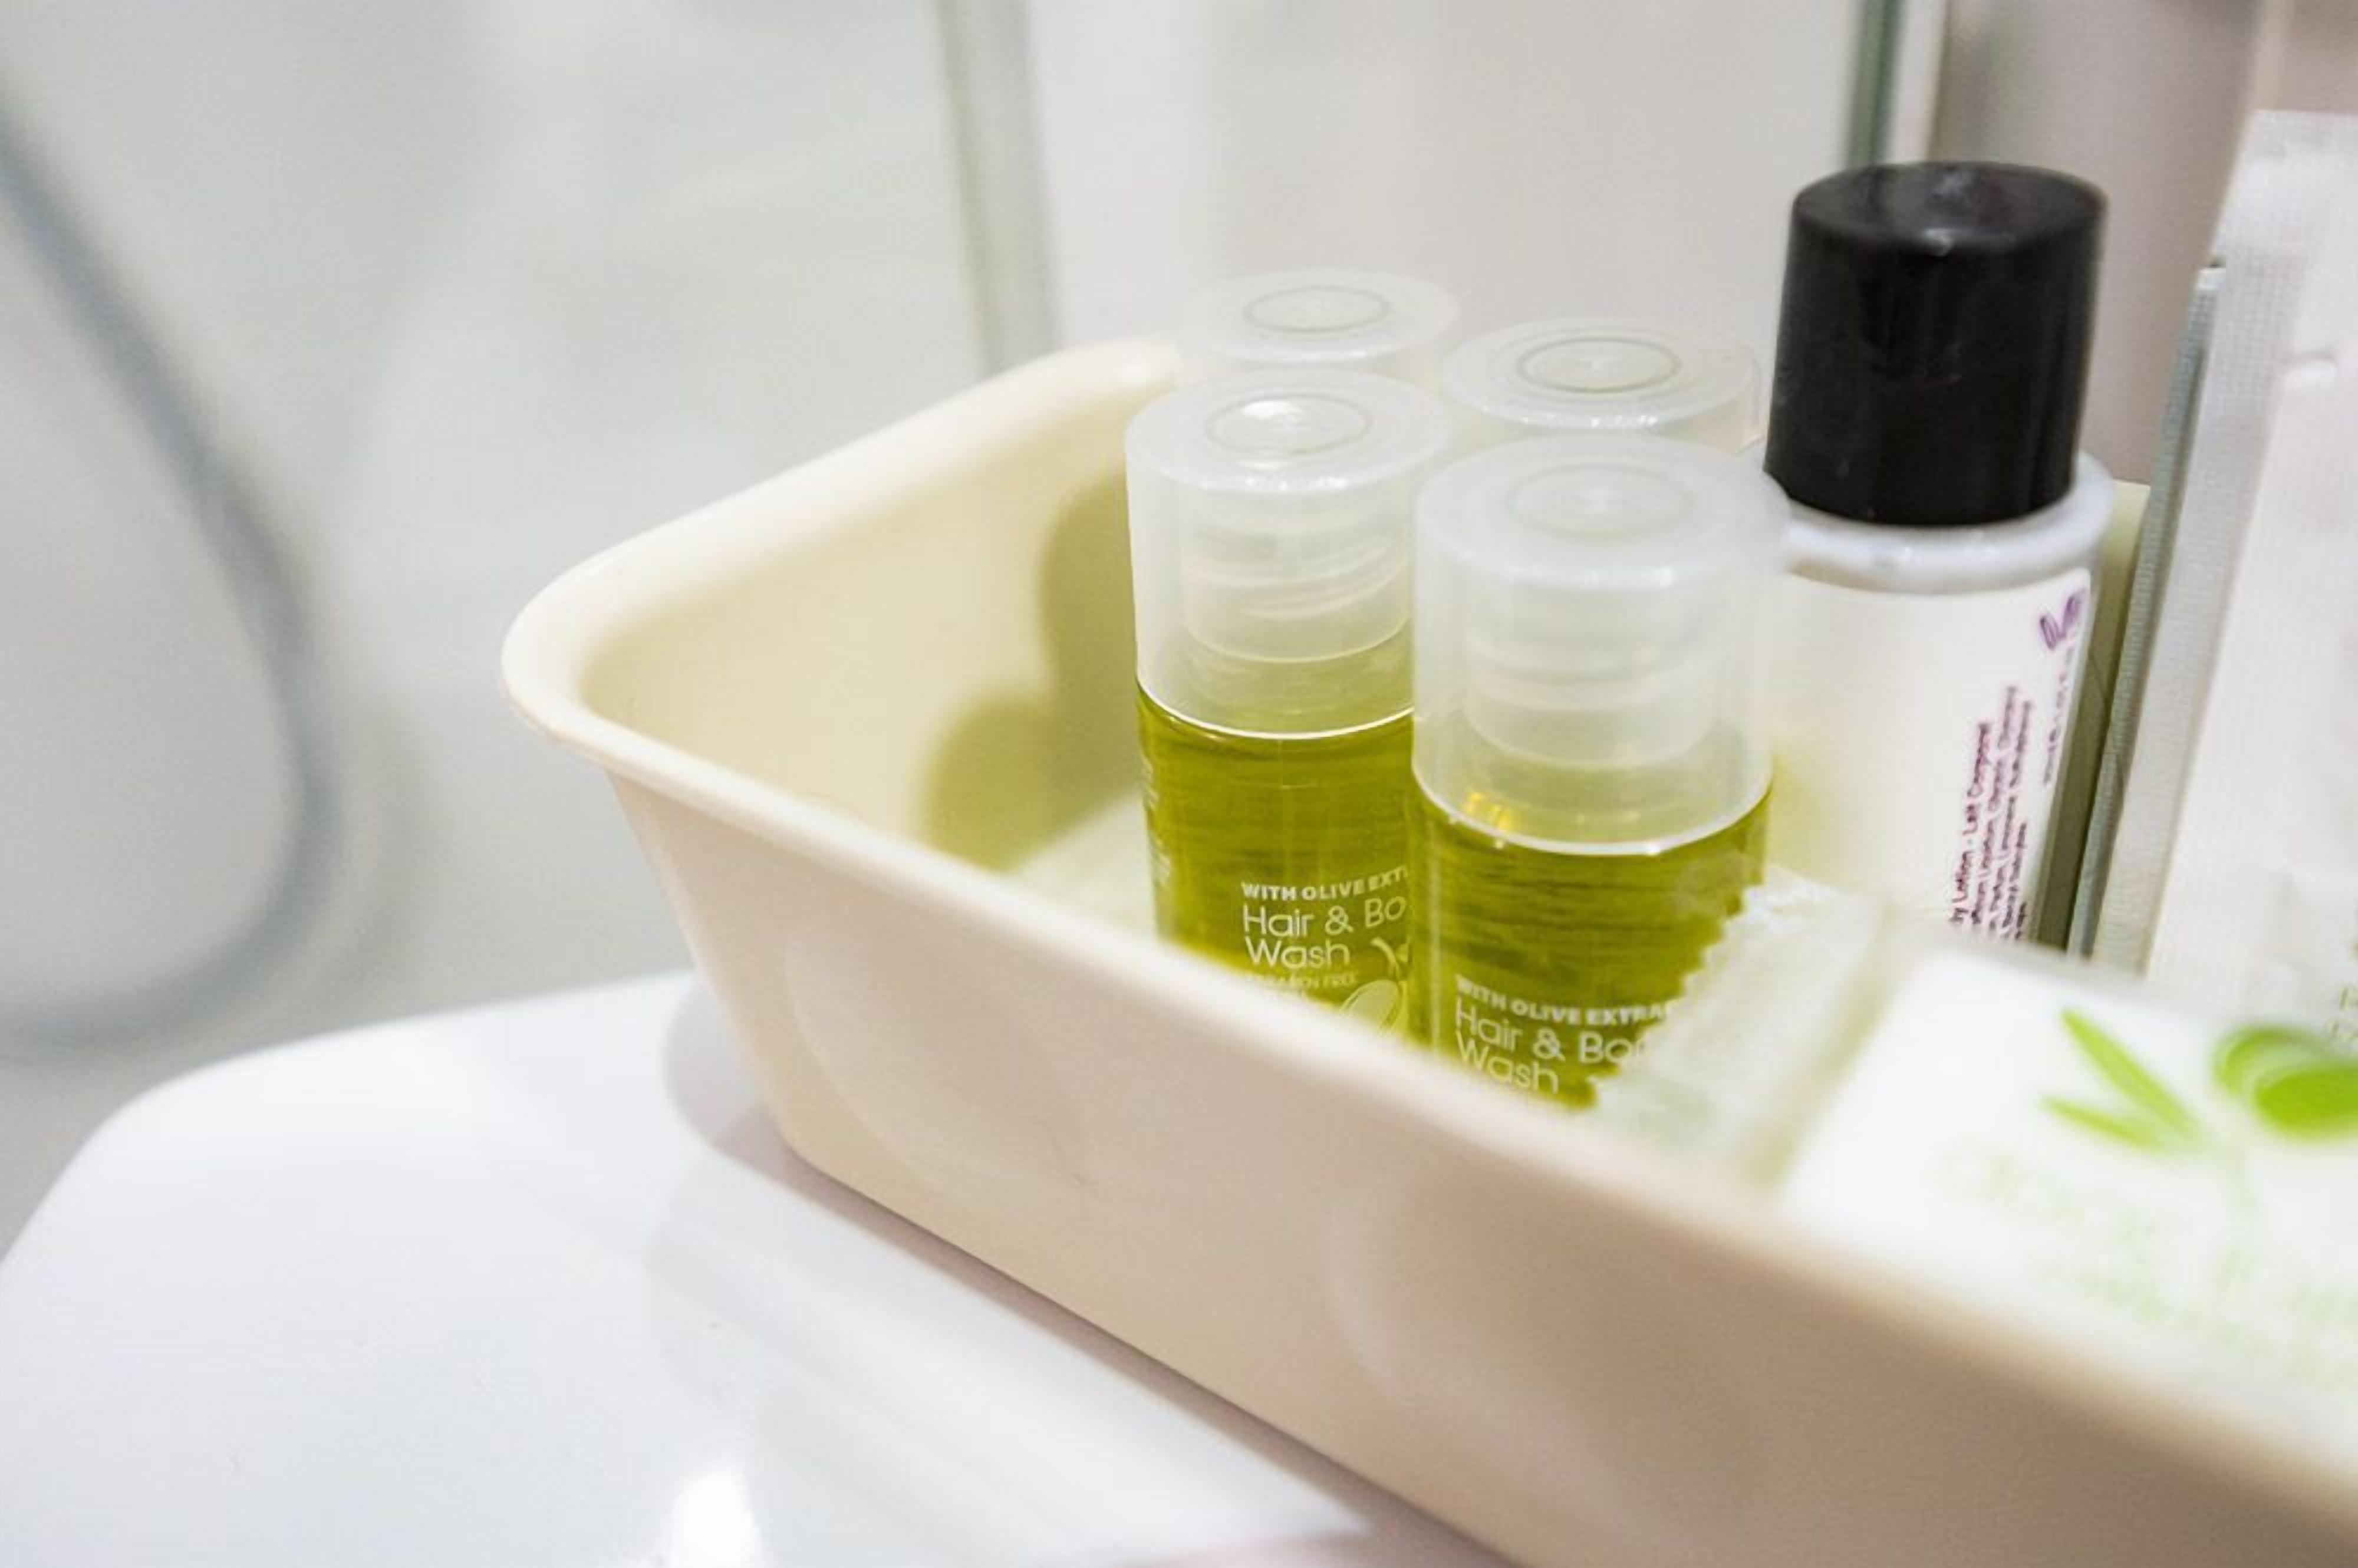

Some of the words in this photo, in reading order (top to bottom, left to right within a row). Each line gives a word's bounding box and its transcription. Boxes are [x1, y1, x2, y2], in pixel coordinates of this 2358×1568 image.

[1241, 881, 1296, 901] WITH
[1301, 878, 1365, 901] OLIVE
[1243, 903, 1315, 938] Hair
[1325, 905, 1355, 935] &
[1244, 935, 1351, 970] Wash
[1455, 974, 1506, 1011] WITH
[1510, 1000, 1581, 1025] OLIVE
[1455, 995, 1523, 1052] Hair
[1534, 1027, 1566, 1061] &
[1455, 1029, 1559, 1093] Wash
